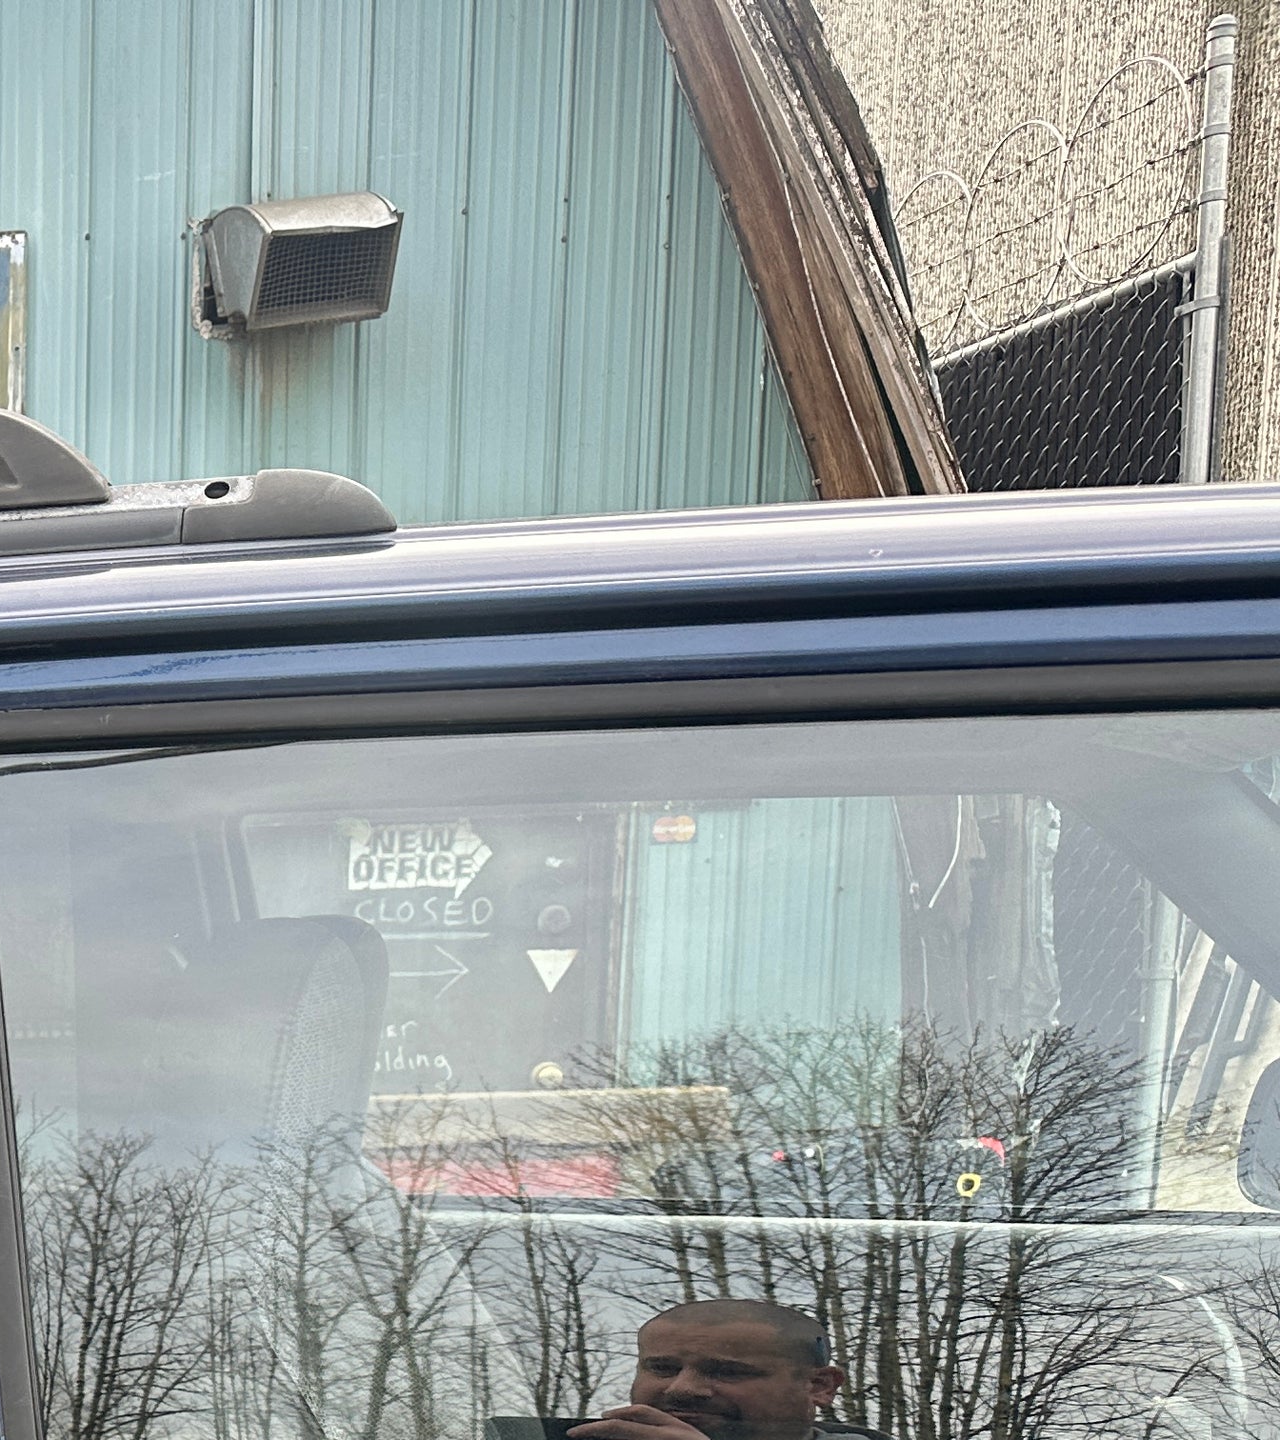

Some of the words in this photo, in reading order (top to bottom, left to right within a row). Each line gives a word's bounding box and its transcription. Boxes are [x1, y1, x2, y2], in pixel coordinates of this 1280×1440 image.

[371, 826, 452, 853] NEW
[352, 854, 476, 883] OFFICE
[354, 896, 493, 926] CLOSED
